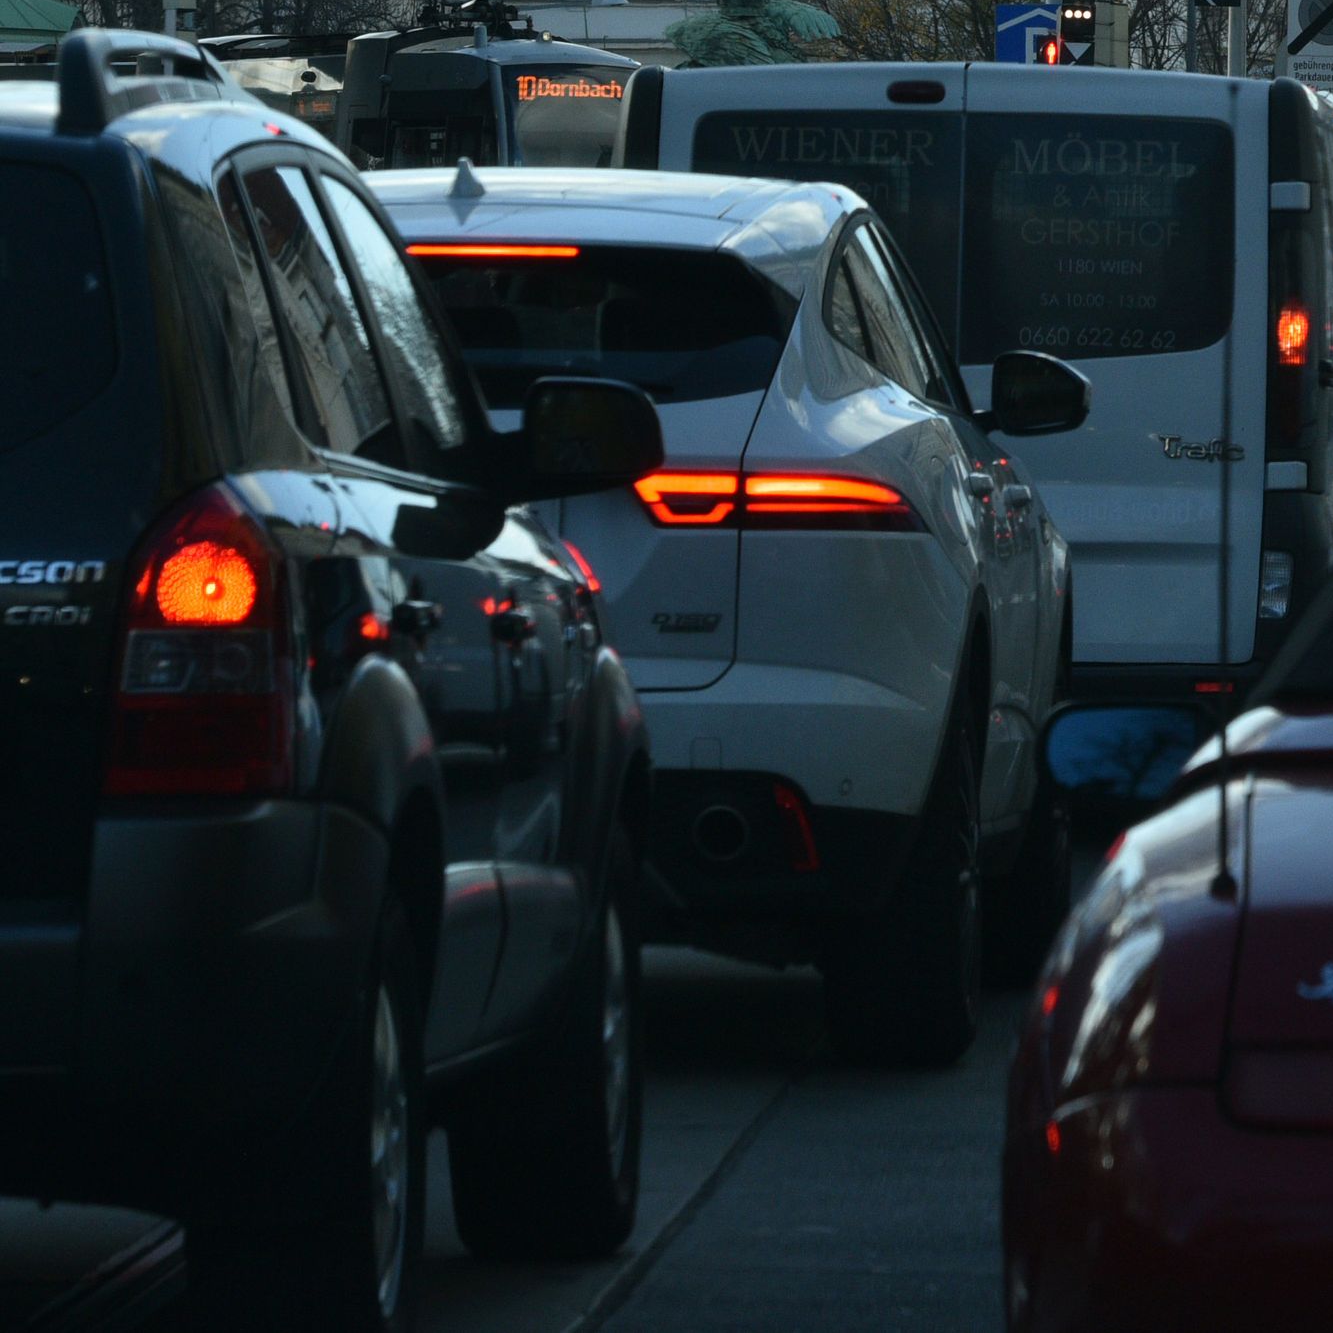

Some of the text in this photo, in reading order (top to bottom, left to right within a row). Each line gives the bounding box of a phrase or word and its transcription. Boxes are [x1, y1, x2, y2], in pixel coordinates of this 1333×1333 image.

[516, 75, 624, 101] 10 Dornbach
[733, 127, 1198, 179] WIENER MÖBEL
[1052, 184, 1072, 208] &
[1020, 217, 1181, 248] GERSTHOF
[1058, 258, 1143, 276] 1180 WIEN
[1019, 326, 1177, 351] 0660 622 62 62
